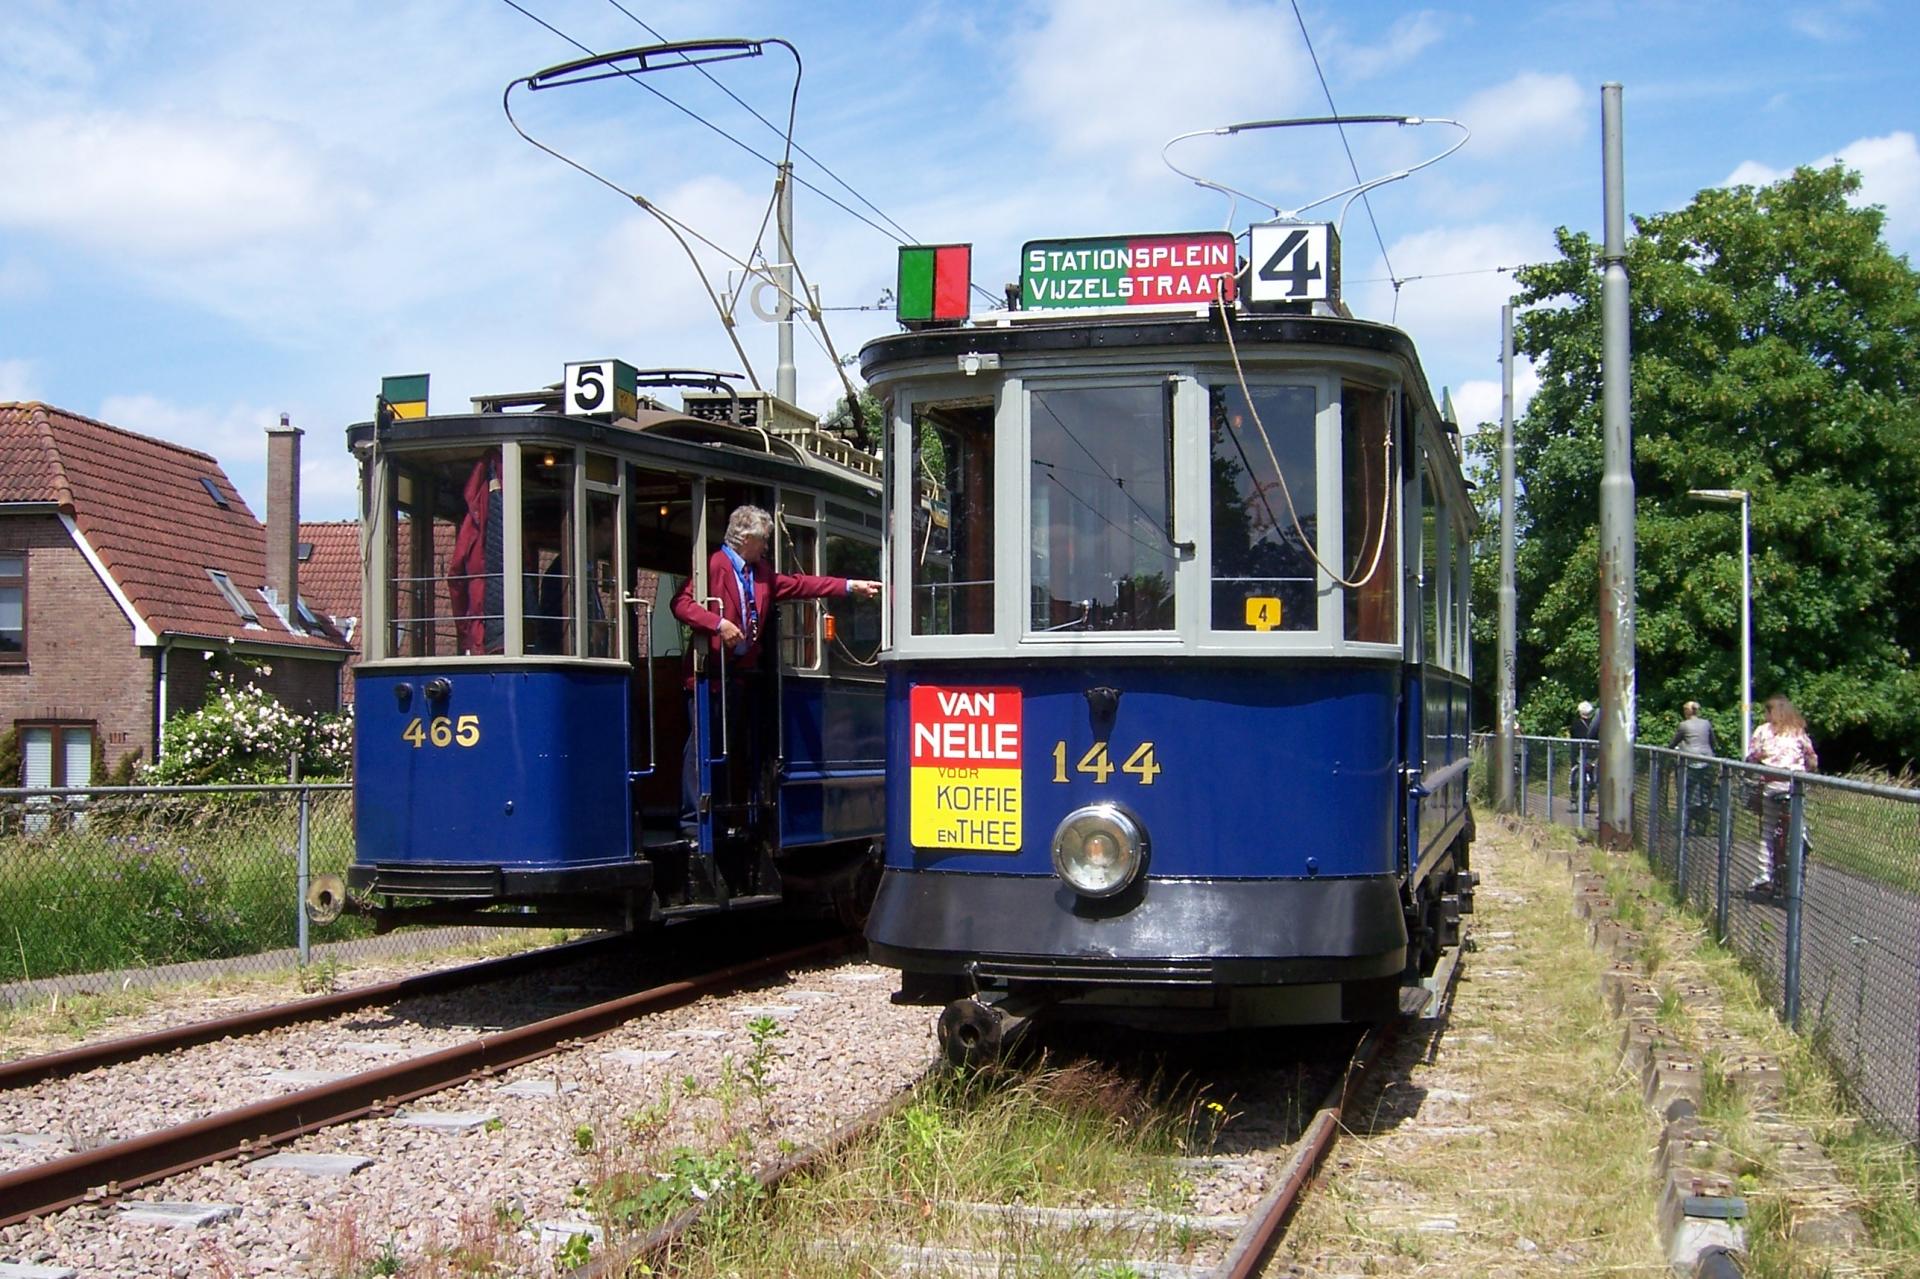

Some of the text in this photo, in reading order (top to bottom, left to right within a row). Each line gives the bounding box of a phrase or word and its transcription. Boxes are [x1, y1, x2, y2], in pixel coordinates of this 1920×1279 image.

[1029, 244, 1229, 273] STATIONSPLEIN
[1258, 229, 1322, 297] 4
[574, 366, 605, 411] 5
[1258, 604, 1268, 623] 4
[937, 692, 995, 717] VAN
[402, 714, 480, 749] 465
[914, 723, 1018, 760] NELLE
[938, 768, 979, 779] VOOR
[1052, 740, 1162, 785] 144
[937, 785, 1017, 813] KOFFIE
